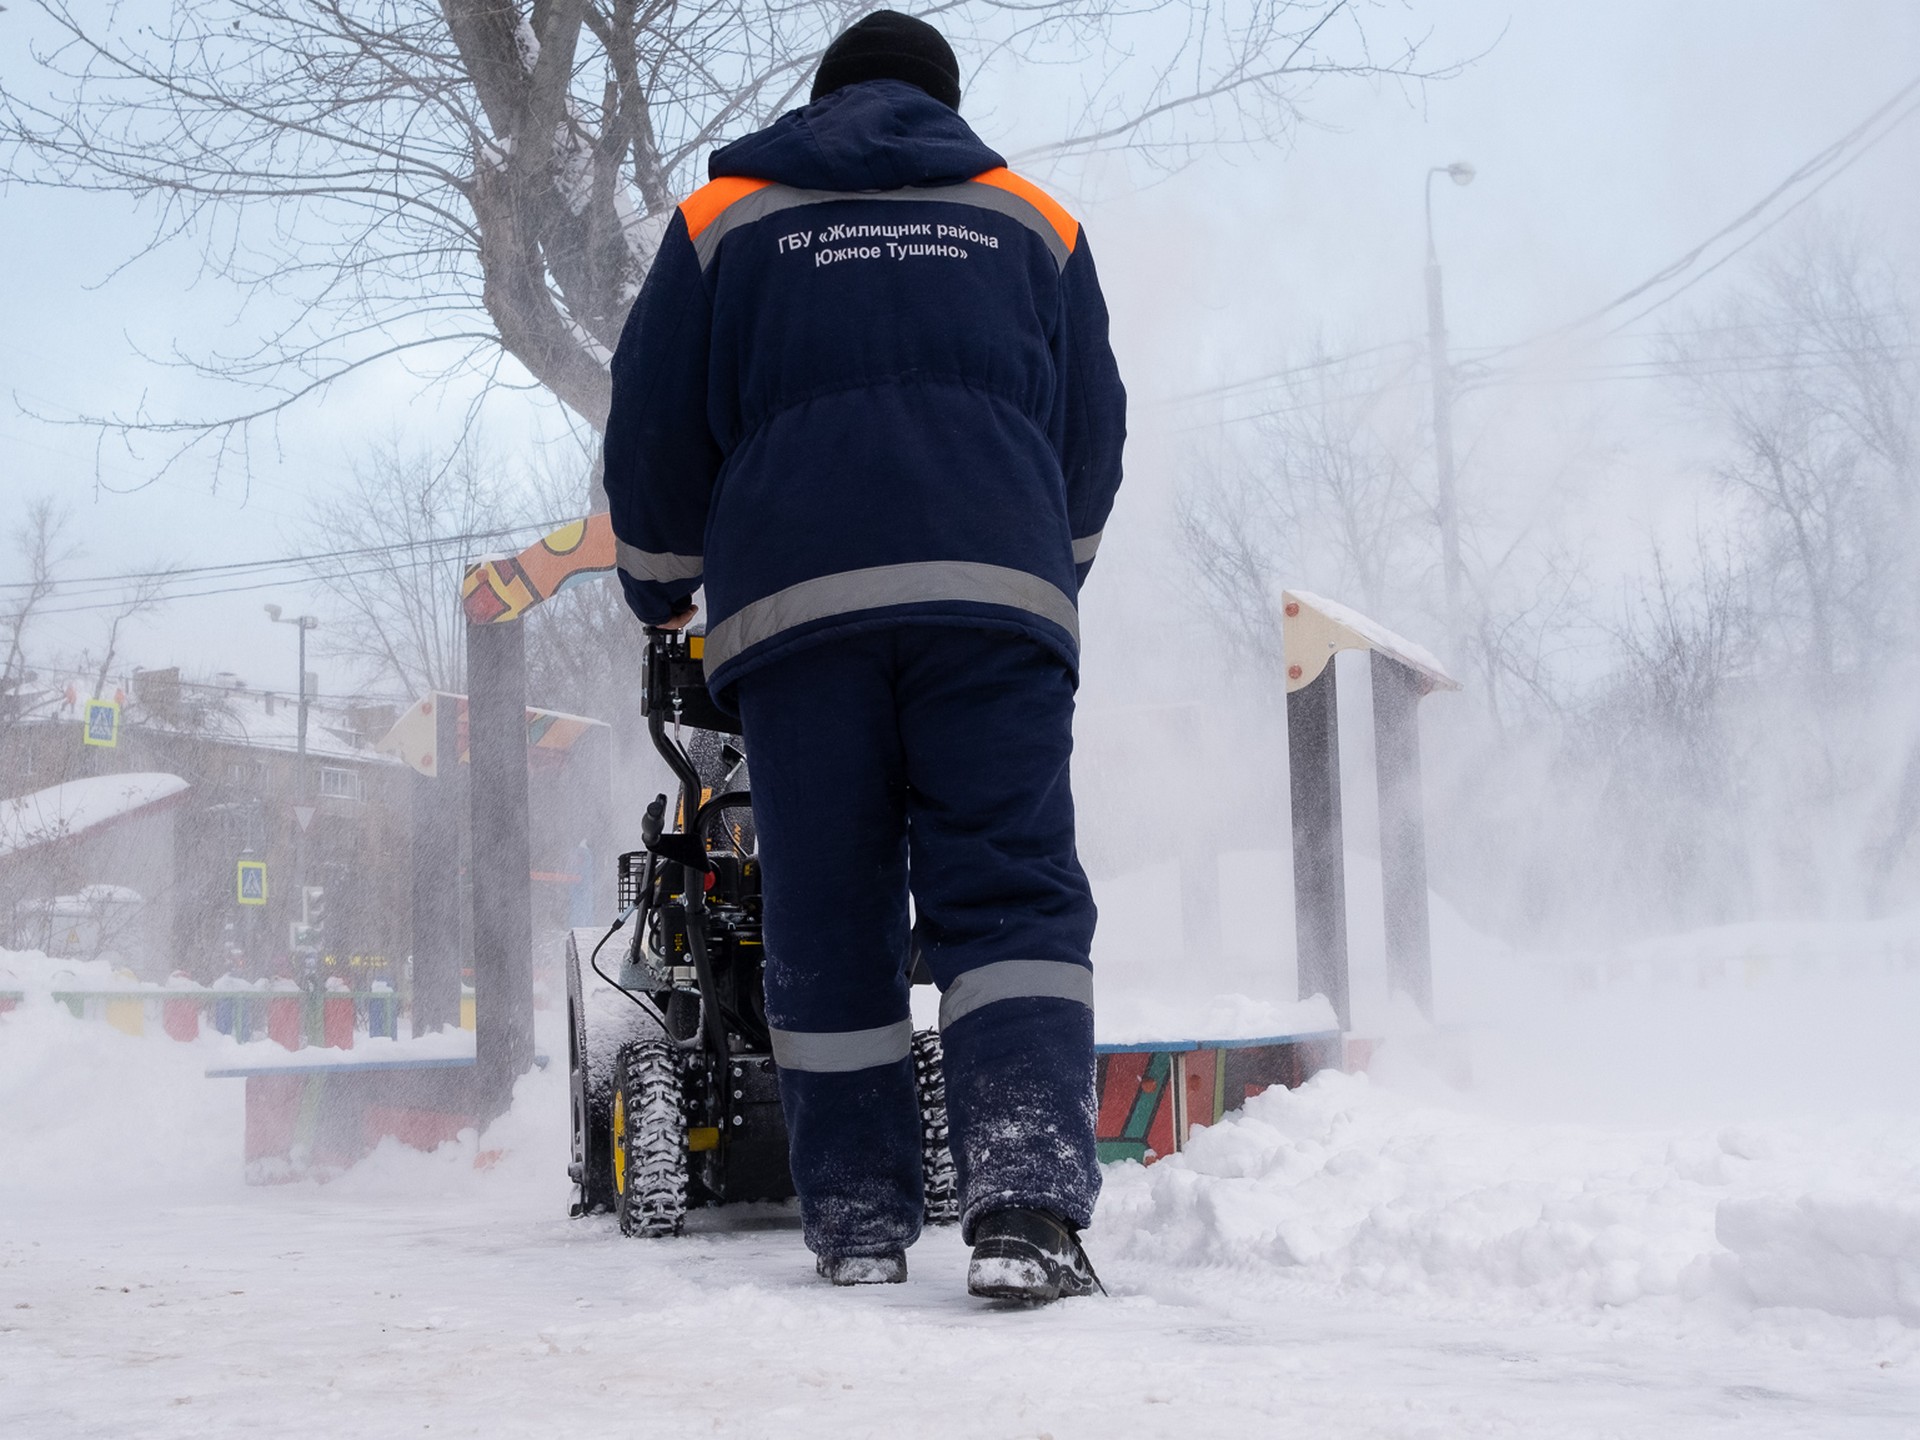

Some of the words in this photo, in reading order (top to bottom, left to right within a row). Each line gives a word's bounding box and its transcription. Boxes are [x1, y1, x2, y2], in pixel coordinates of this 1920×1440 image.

[778, 230, 813, 254] ГБУ
[818, 223, 932, 243] «Жилищник
[936, 224, 999, 249] района
[815, 247, 882, 267] Южное
[885, 242, 968, 260] Тушино»
